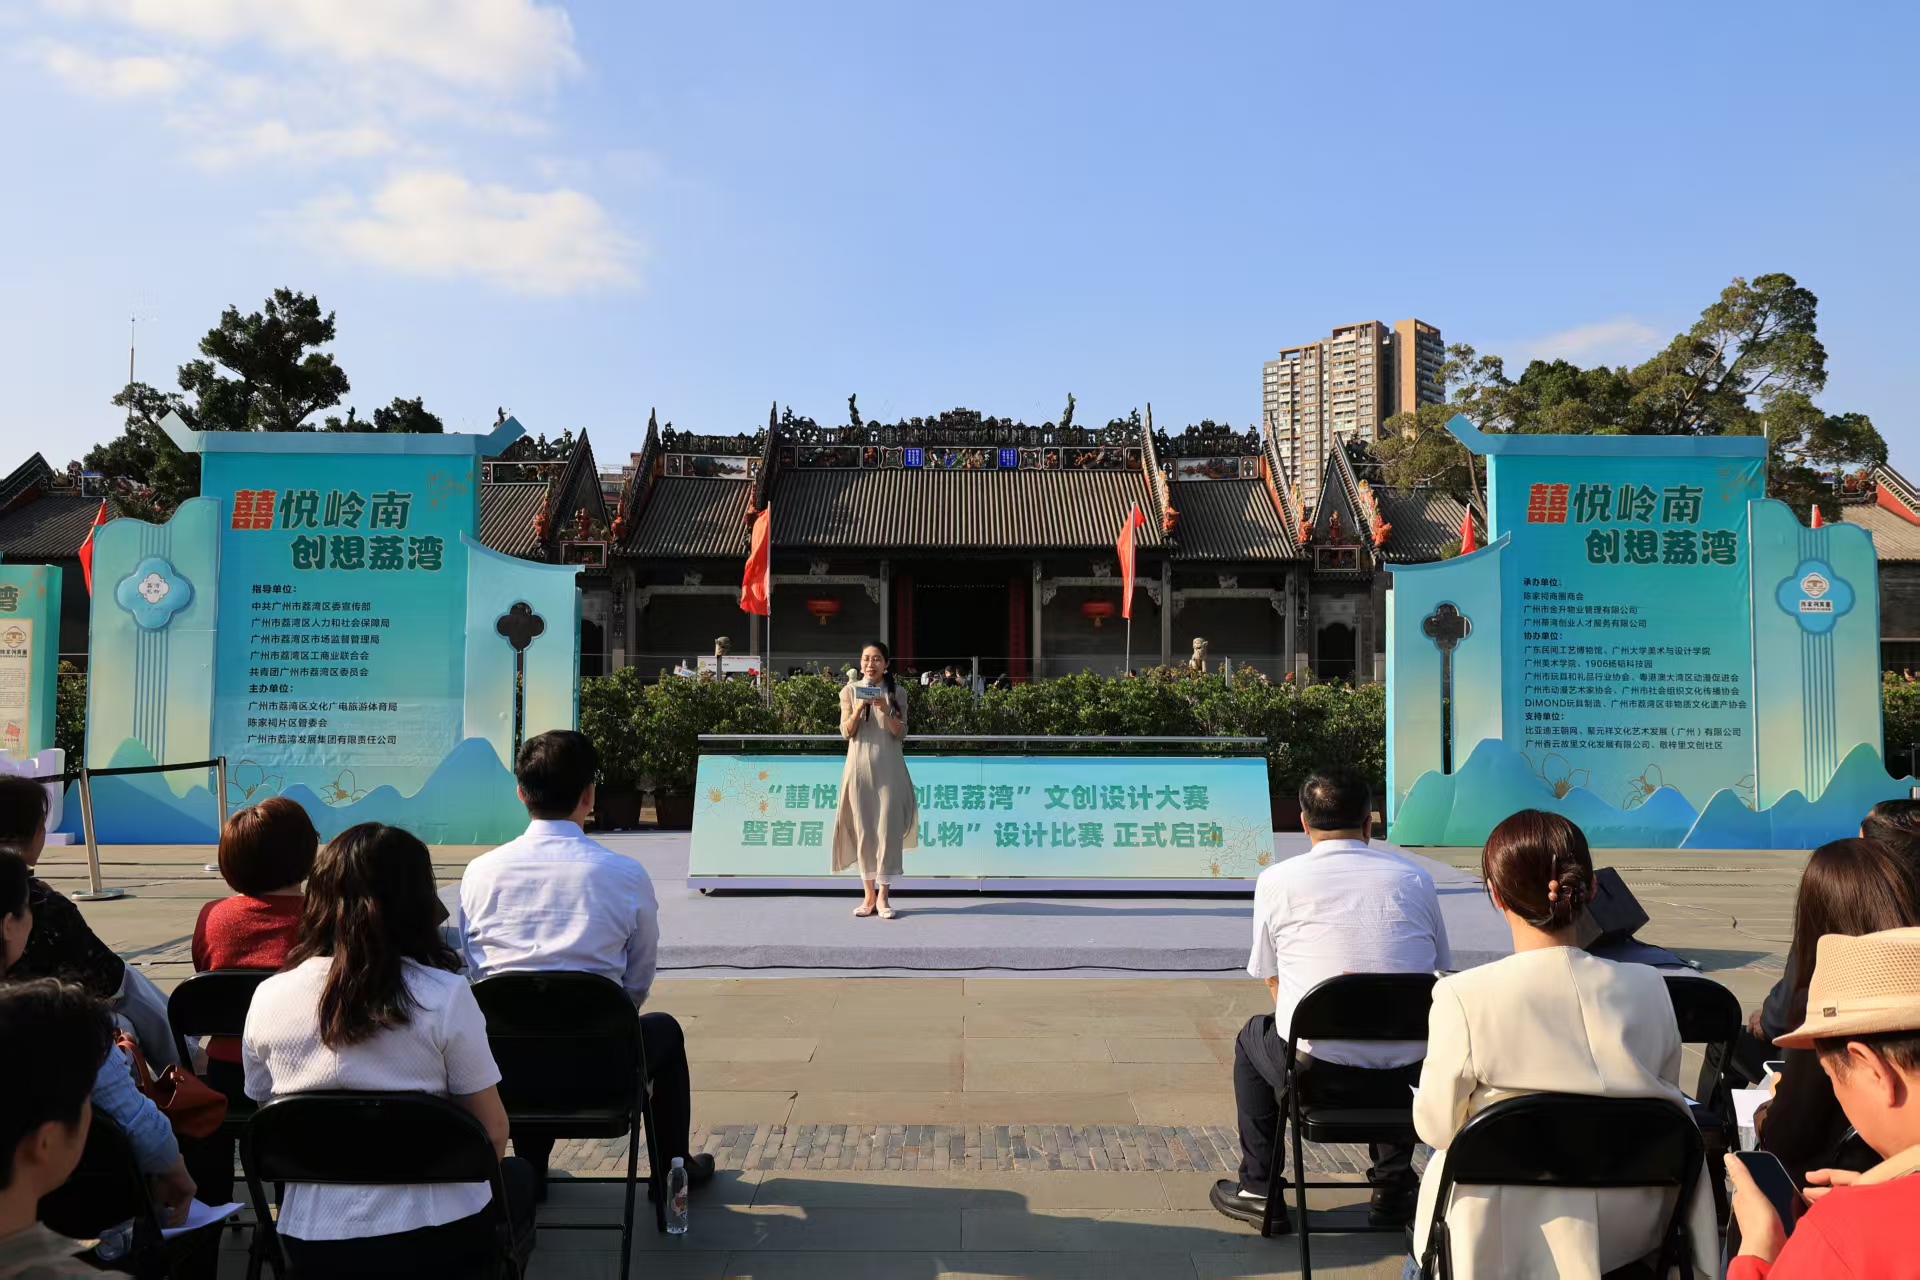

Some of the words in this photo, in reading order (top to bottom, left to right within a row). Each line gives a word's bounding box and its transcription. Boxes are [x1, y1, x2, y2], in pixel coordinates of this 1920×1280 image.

[1527, 482, 1703, 524] 囍悦岭南
[231, 488, 412, 530] 囍悦岭南
[1585, 528, 1737, 565] 创想荔湾
[290, 534, 444, 571] 创想荔湾
[1523, 577, 1562, 587] 承办单位：
[252, 584, 297, 594] 指导单位：
[252, 602, 371, 611] 中共广州市荔湾区委宣传部
[1523, 605, 1638, 615] 广州市金升物业管理有限公司
[251, 618, 390, 628] 广州市荔湾区人力和社会保障局
[250, 634, 380, 644] 广州市荔湾区市场监督管理局
[1524, 631, 1563, 640] 协办单位：
[250, 650, 369, 661] 广州市荔湾区工商业联合会
[1524, 645, 1711, 656] 广东民间工艺博物馆、广州大学美术与设计学院
[249, 667, 369, 677] 共青团广州市荔湾区委员会
[249, 683, 294, 693] 主办单位：
[1524, 685, 1739, 696] 广州市动漫艺术家协会、广州市社会组织文化传播协会
[248, 701, 398, 712] 广州市荔湾区文化广电旅游体育局
[1525, 712, 1564, 721] 支持单位：
[247, 718, 328, 728] 陈家祠片区管委会
[247, 734, 397, 745] 广州市荔湾发展集团有限责任公司
